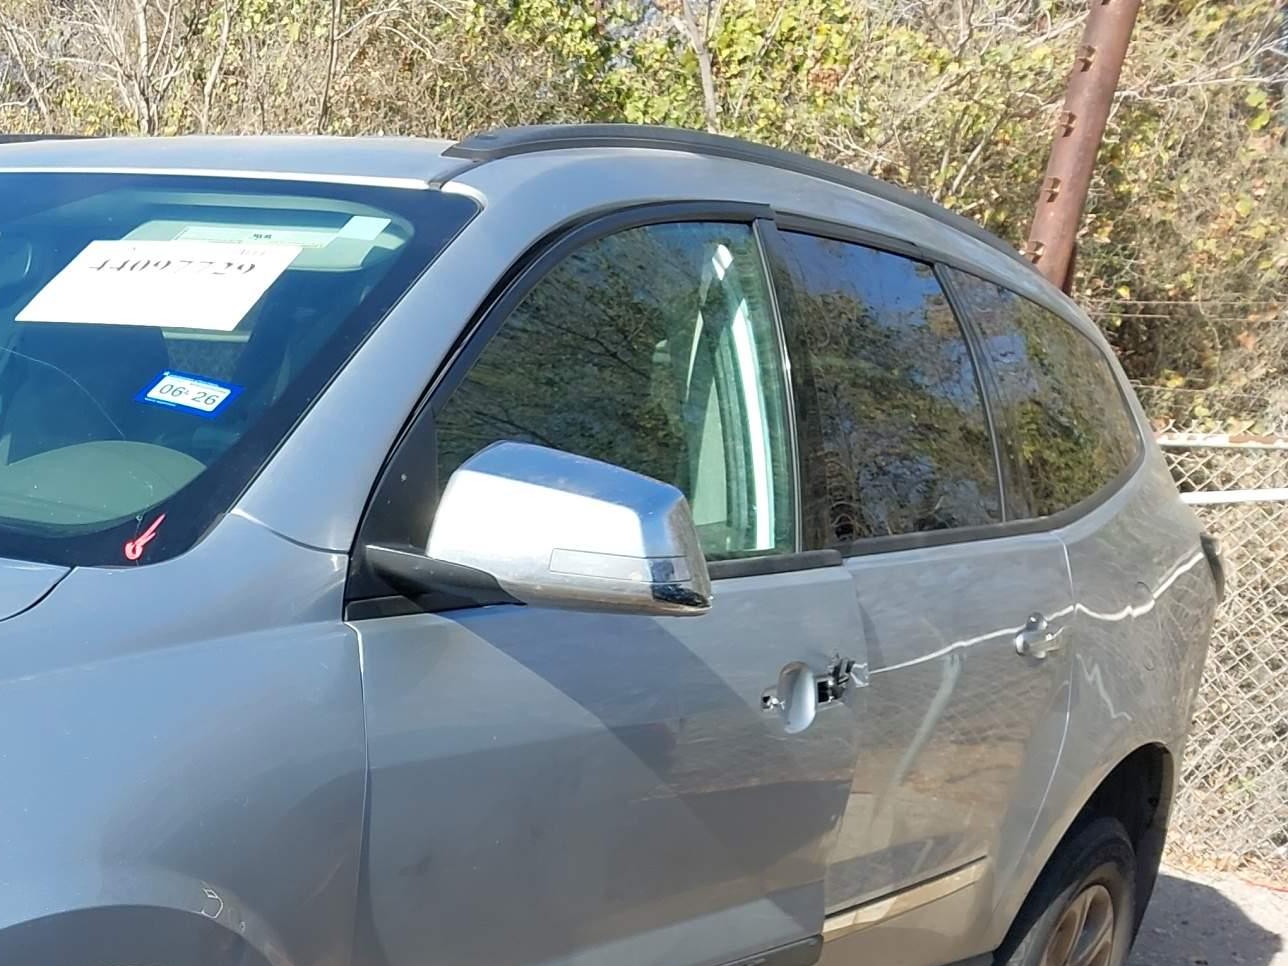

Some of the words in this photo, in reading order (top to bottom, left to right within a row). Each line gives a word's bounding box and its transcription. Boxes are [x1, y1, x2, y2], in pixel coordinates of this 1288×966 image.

[88, 258, 256, 275] 44097729
[158, 383, 186, 398] 06
[191, 391, 219, 406] 26
